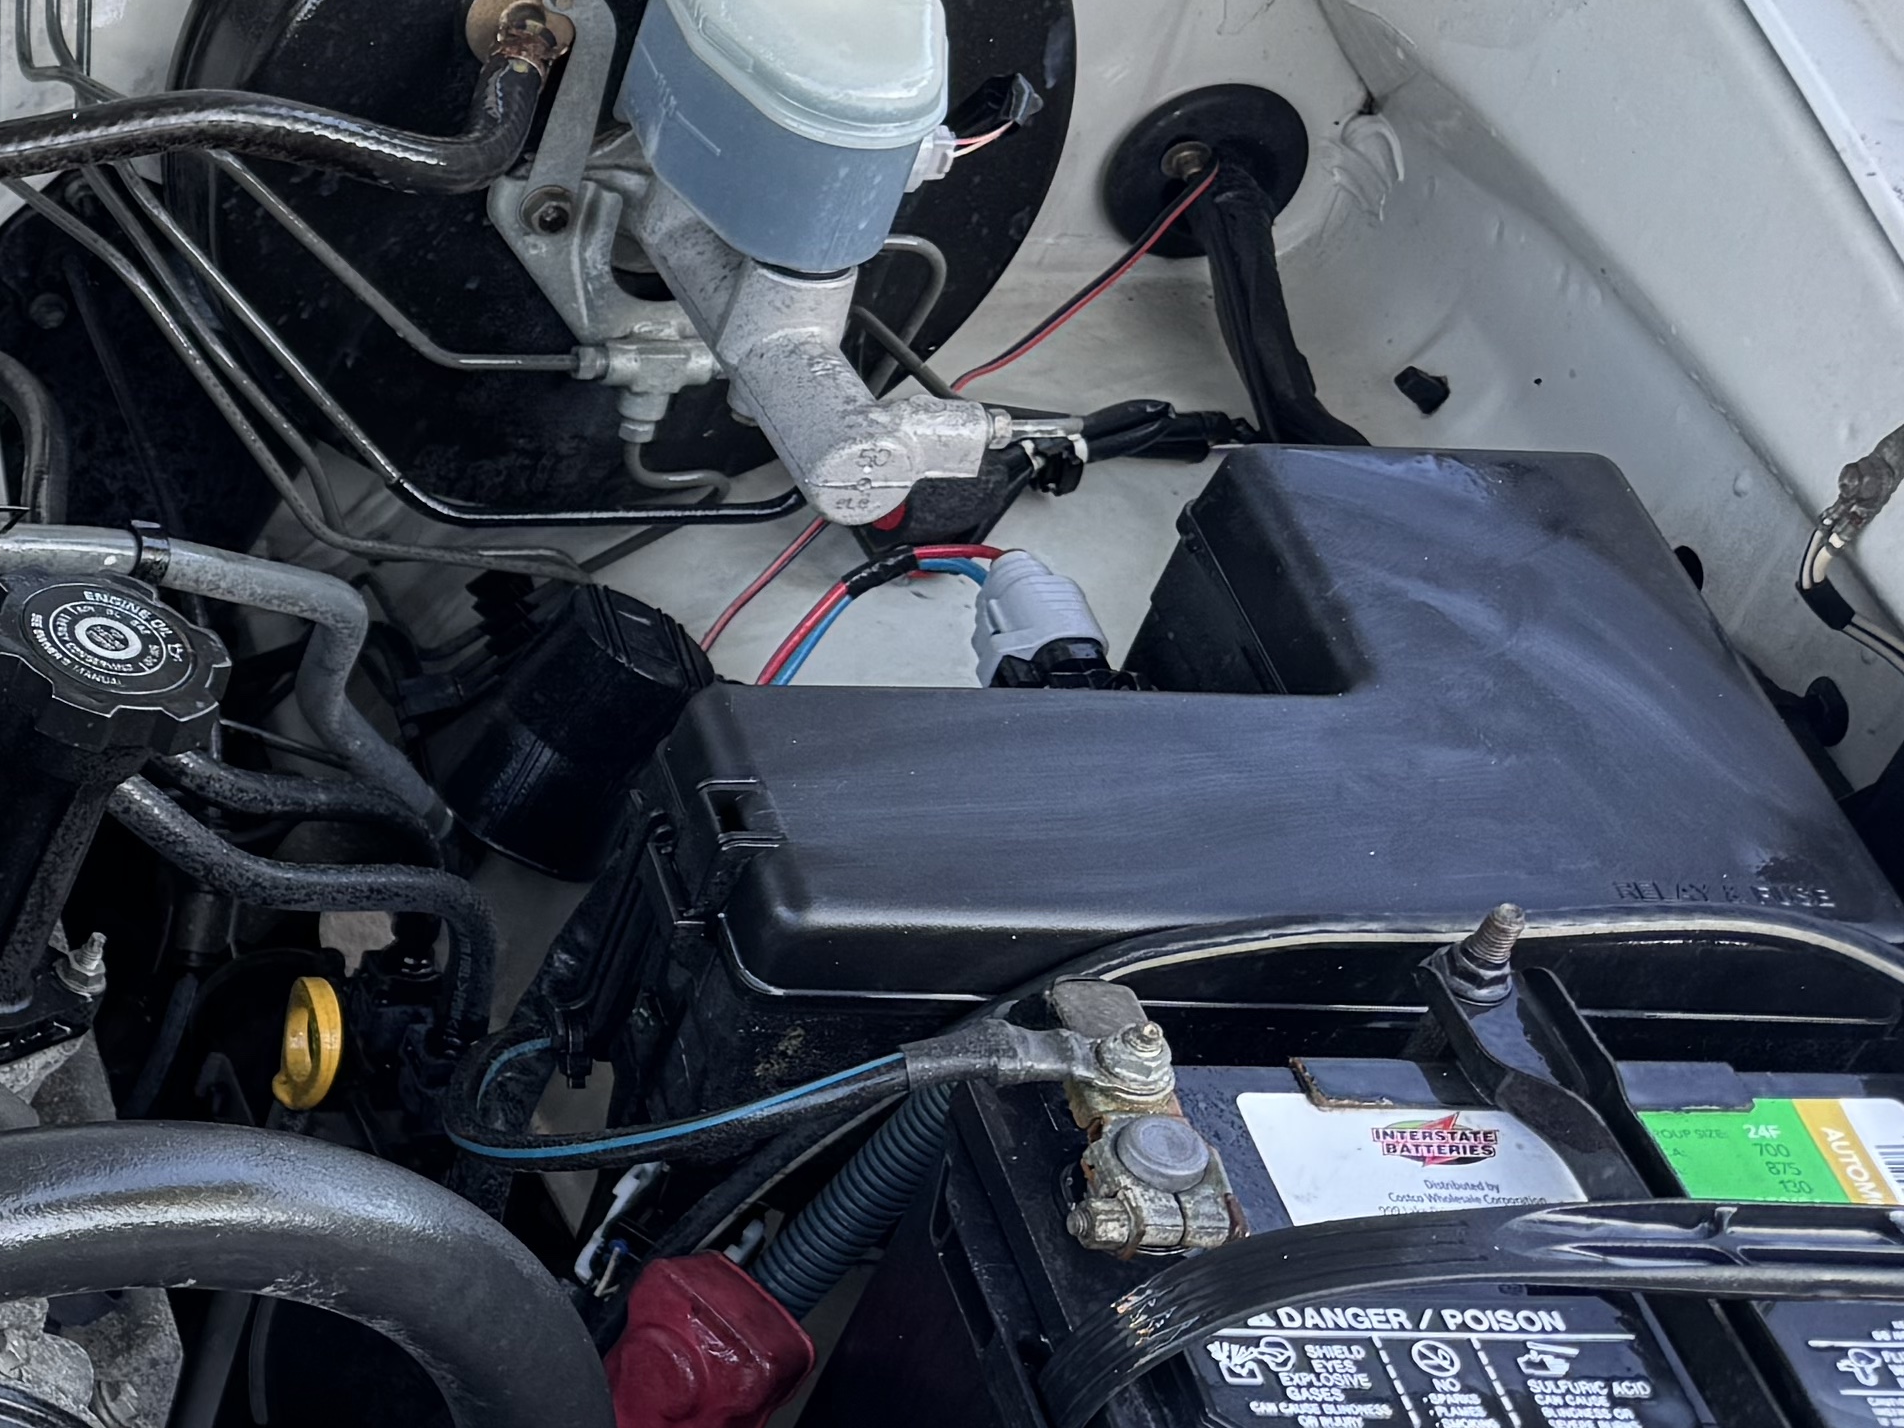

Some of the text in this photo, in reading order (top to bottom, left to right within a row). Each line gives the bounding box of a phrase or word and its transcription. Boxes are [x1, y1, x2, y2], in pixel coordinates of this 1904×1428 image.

[82, 590, 150, 621] ENGINE
[150, 618, 174, 639] OIL
[1374, 1129, 1493, 1143] INTERSTATE
[1653, 1128, 1729, 1140] ROUP SIZE:
[1743, 1124, 1782, 1139] 24F
[1385, 1143, 1494, 1156] BATTERIES
[1752, 1143, 1791, 1157] 700
[1765, 1161, 1802, 1176] 875
[1424, 1179, 1500, 1194] Distributed by
[1779, 1179, 1814, 1194] 130
[1388, 1192, 1424, 1203] Costco
[1426, 1193, 1482, 1204] Wholesale
[1276, 1306, 1413, 1330] DANGER
[1440, 1308, 1567, 1332] POISON
[1304, 1344, 1366, 1360] SHIELD
[1310, 1359, 1358, 1373] EYES
[1278, 1371, 1372, 1389] EXPLOSIVE
[1431, 1378, 1462, 1392] NO
[1285, 1386, 1346, 1402] GASES
[1526, 1378, 1652, 1399] SULFURIC ACID
[1430, 1393, 1482, 1406] SPARKS
[1534, 1394, 1611, 1408] CAN CAUSE
